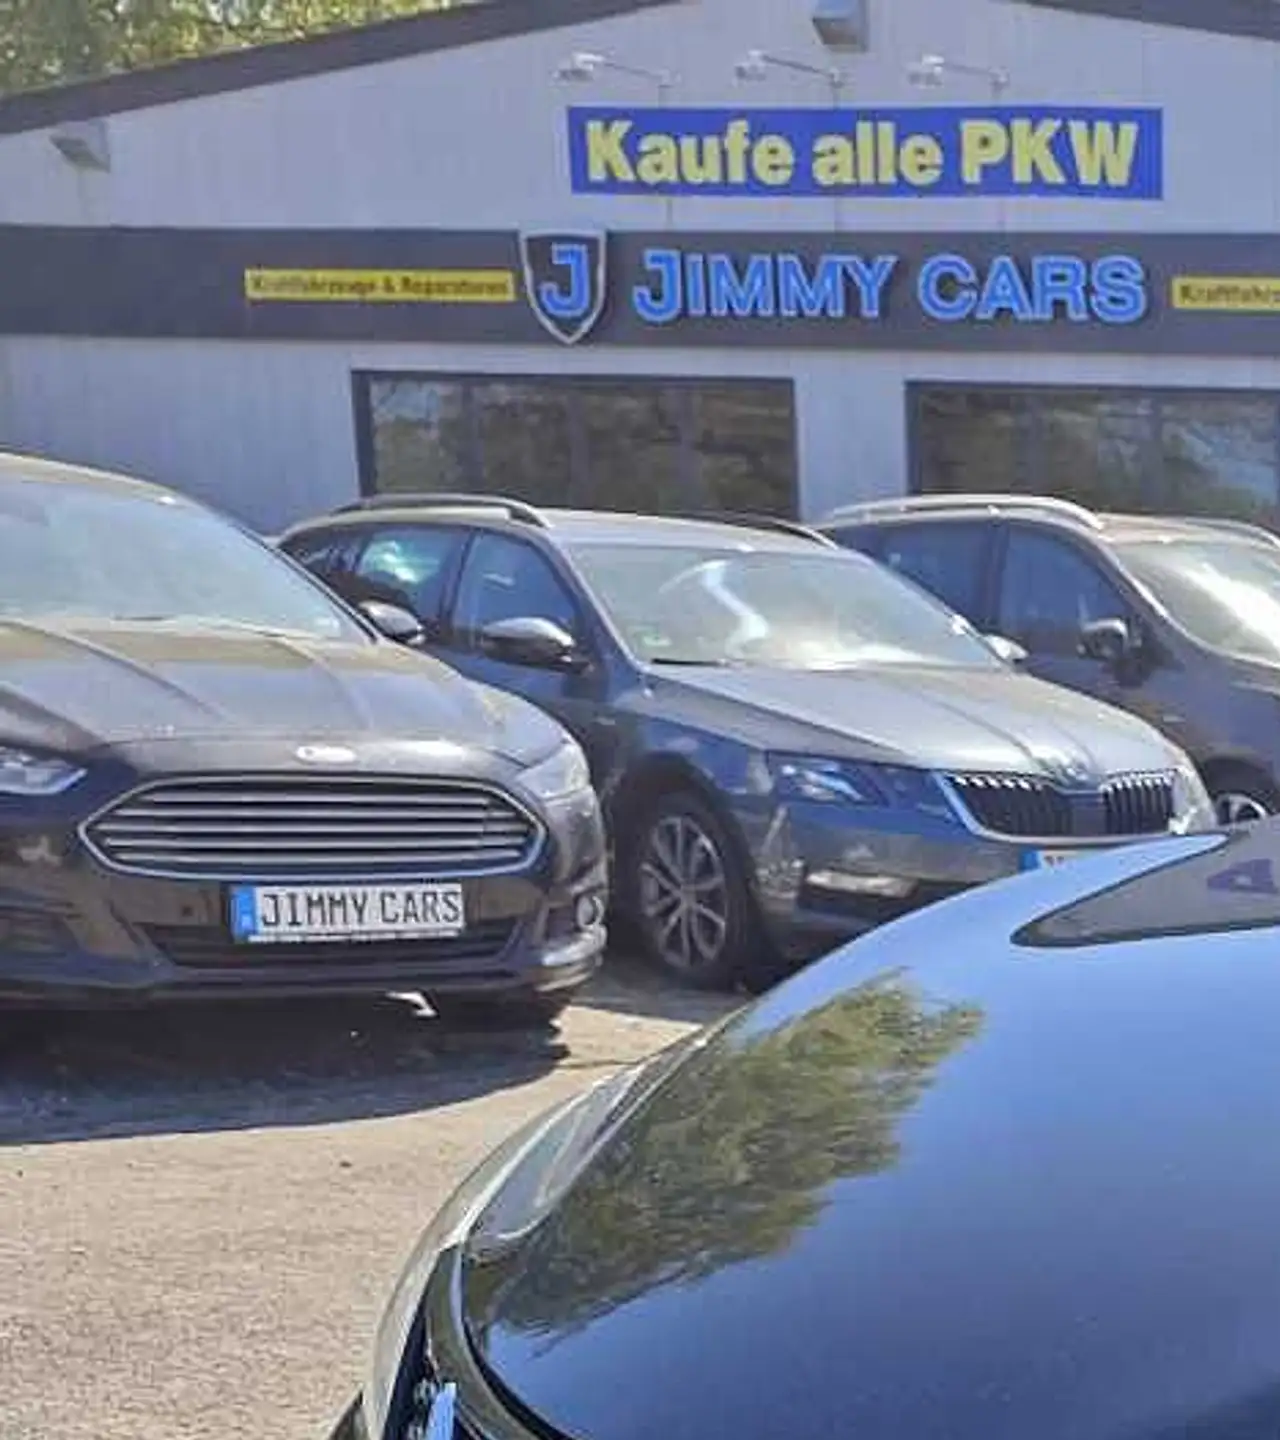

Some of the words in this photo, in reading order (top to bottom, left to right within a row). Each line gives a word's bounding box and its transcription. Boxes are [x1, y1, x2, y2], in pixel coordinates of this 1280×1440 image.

[585, 119, 796, 185] Kaufe
[811, 120, 944, 186] alle
[959, 120, 1139, 186] PKW
[540, 243, 589, 318] J
[633, 249, 899, 325] JIMMY
[918, 252, 1146, 325] CARS
[262, 894, 369, 926] JIMMY
[379, 890, 460, 923] CARS
